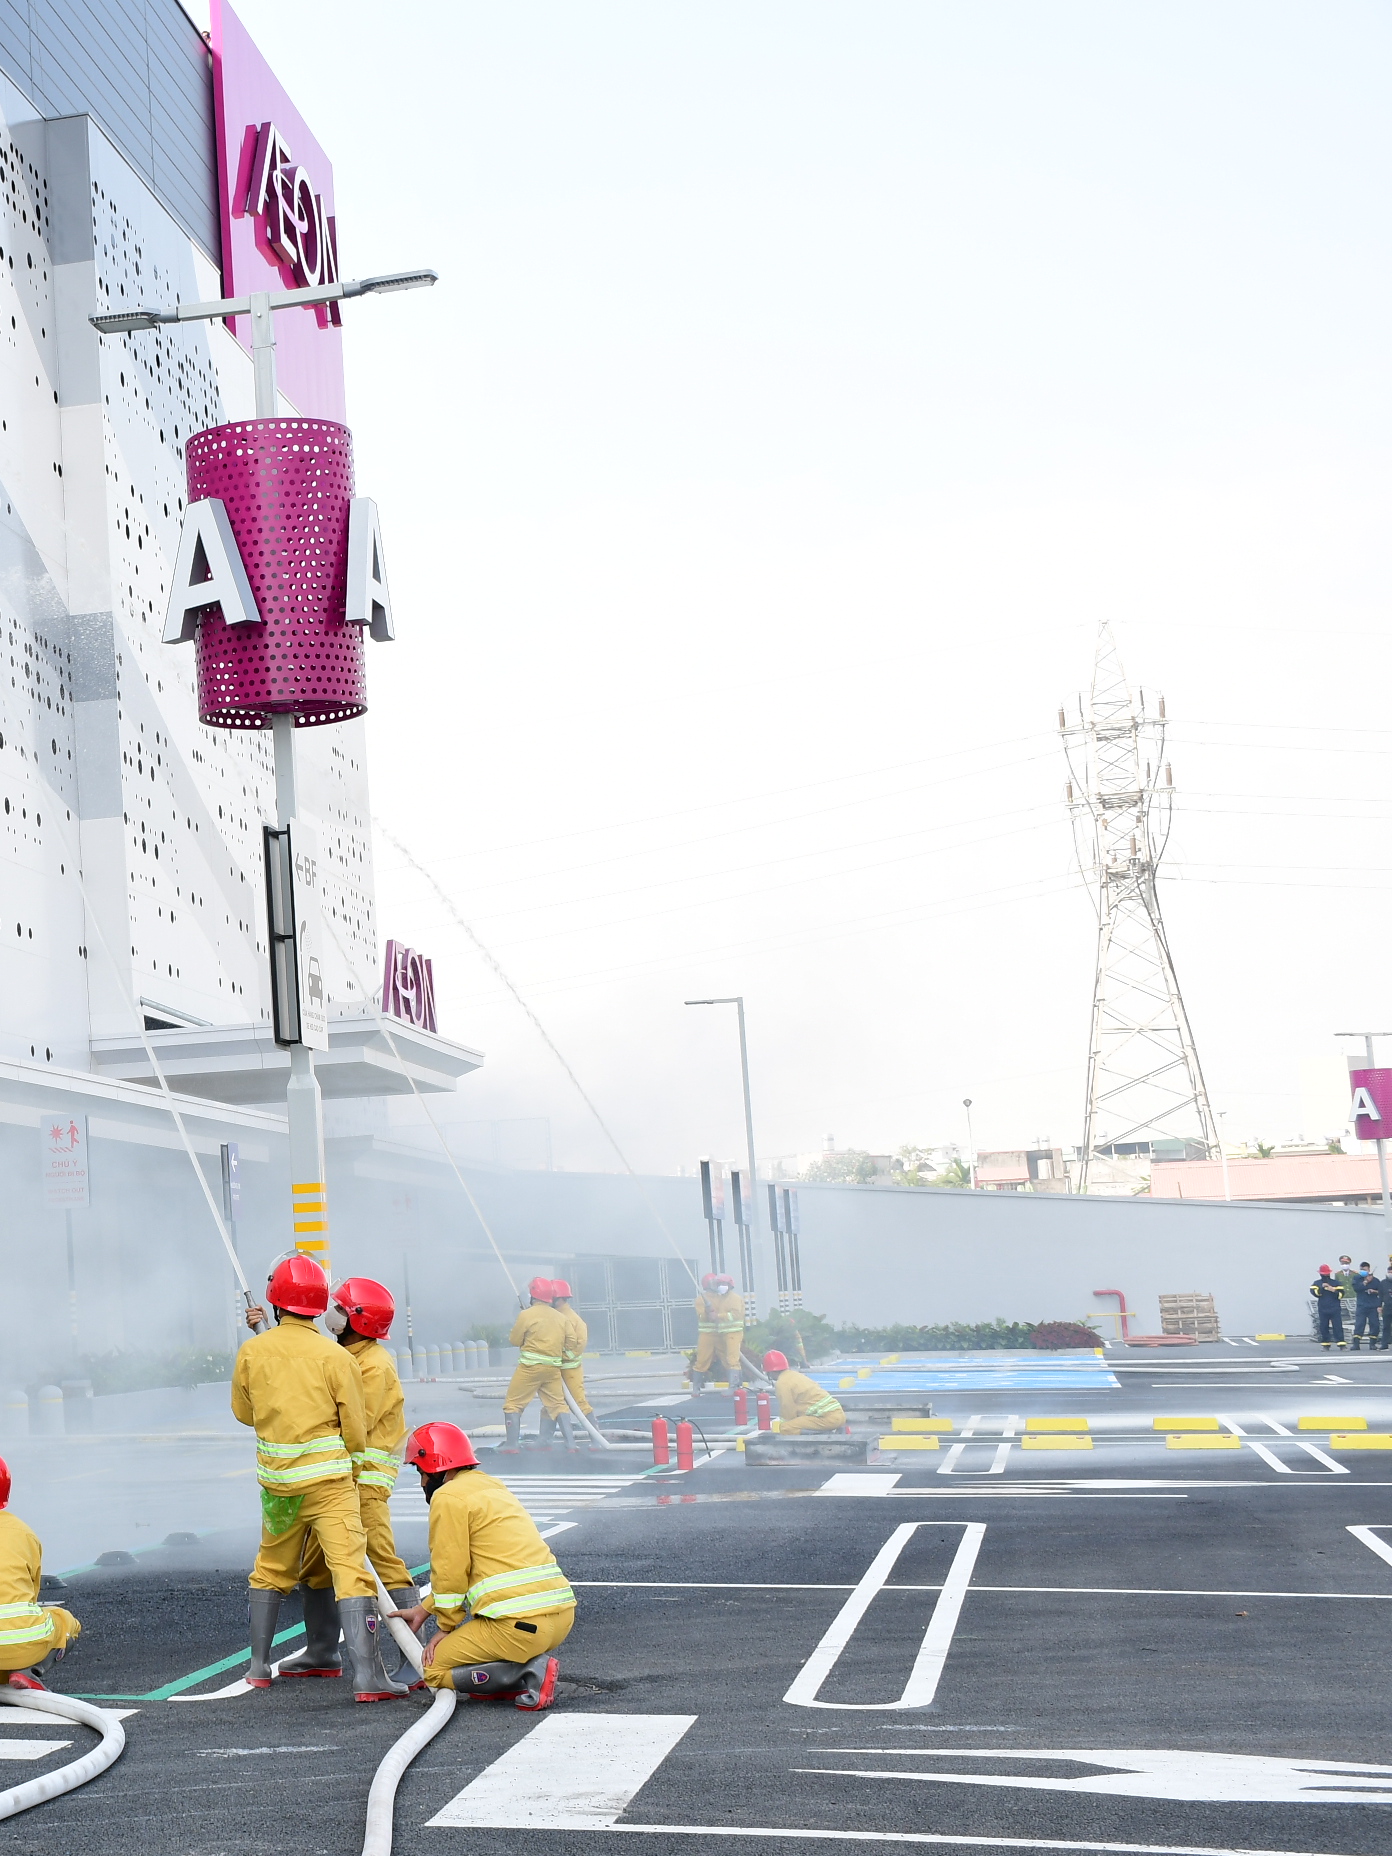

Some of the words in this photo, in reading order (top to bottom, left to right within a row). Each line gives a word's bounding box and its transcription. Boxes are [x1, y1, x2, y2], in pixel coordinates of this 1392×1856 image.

[162, 496, 261, 643] A
[345, 496, 395, 643] A
[304, 856, 317, 888] BF
[382, 939, 438, 1034] AEON
[1348, 1087, 1382, 1122] A
